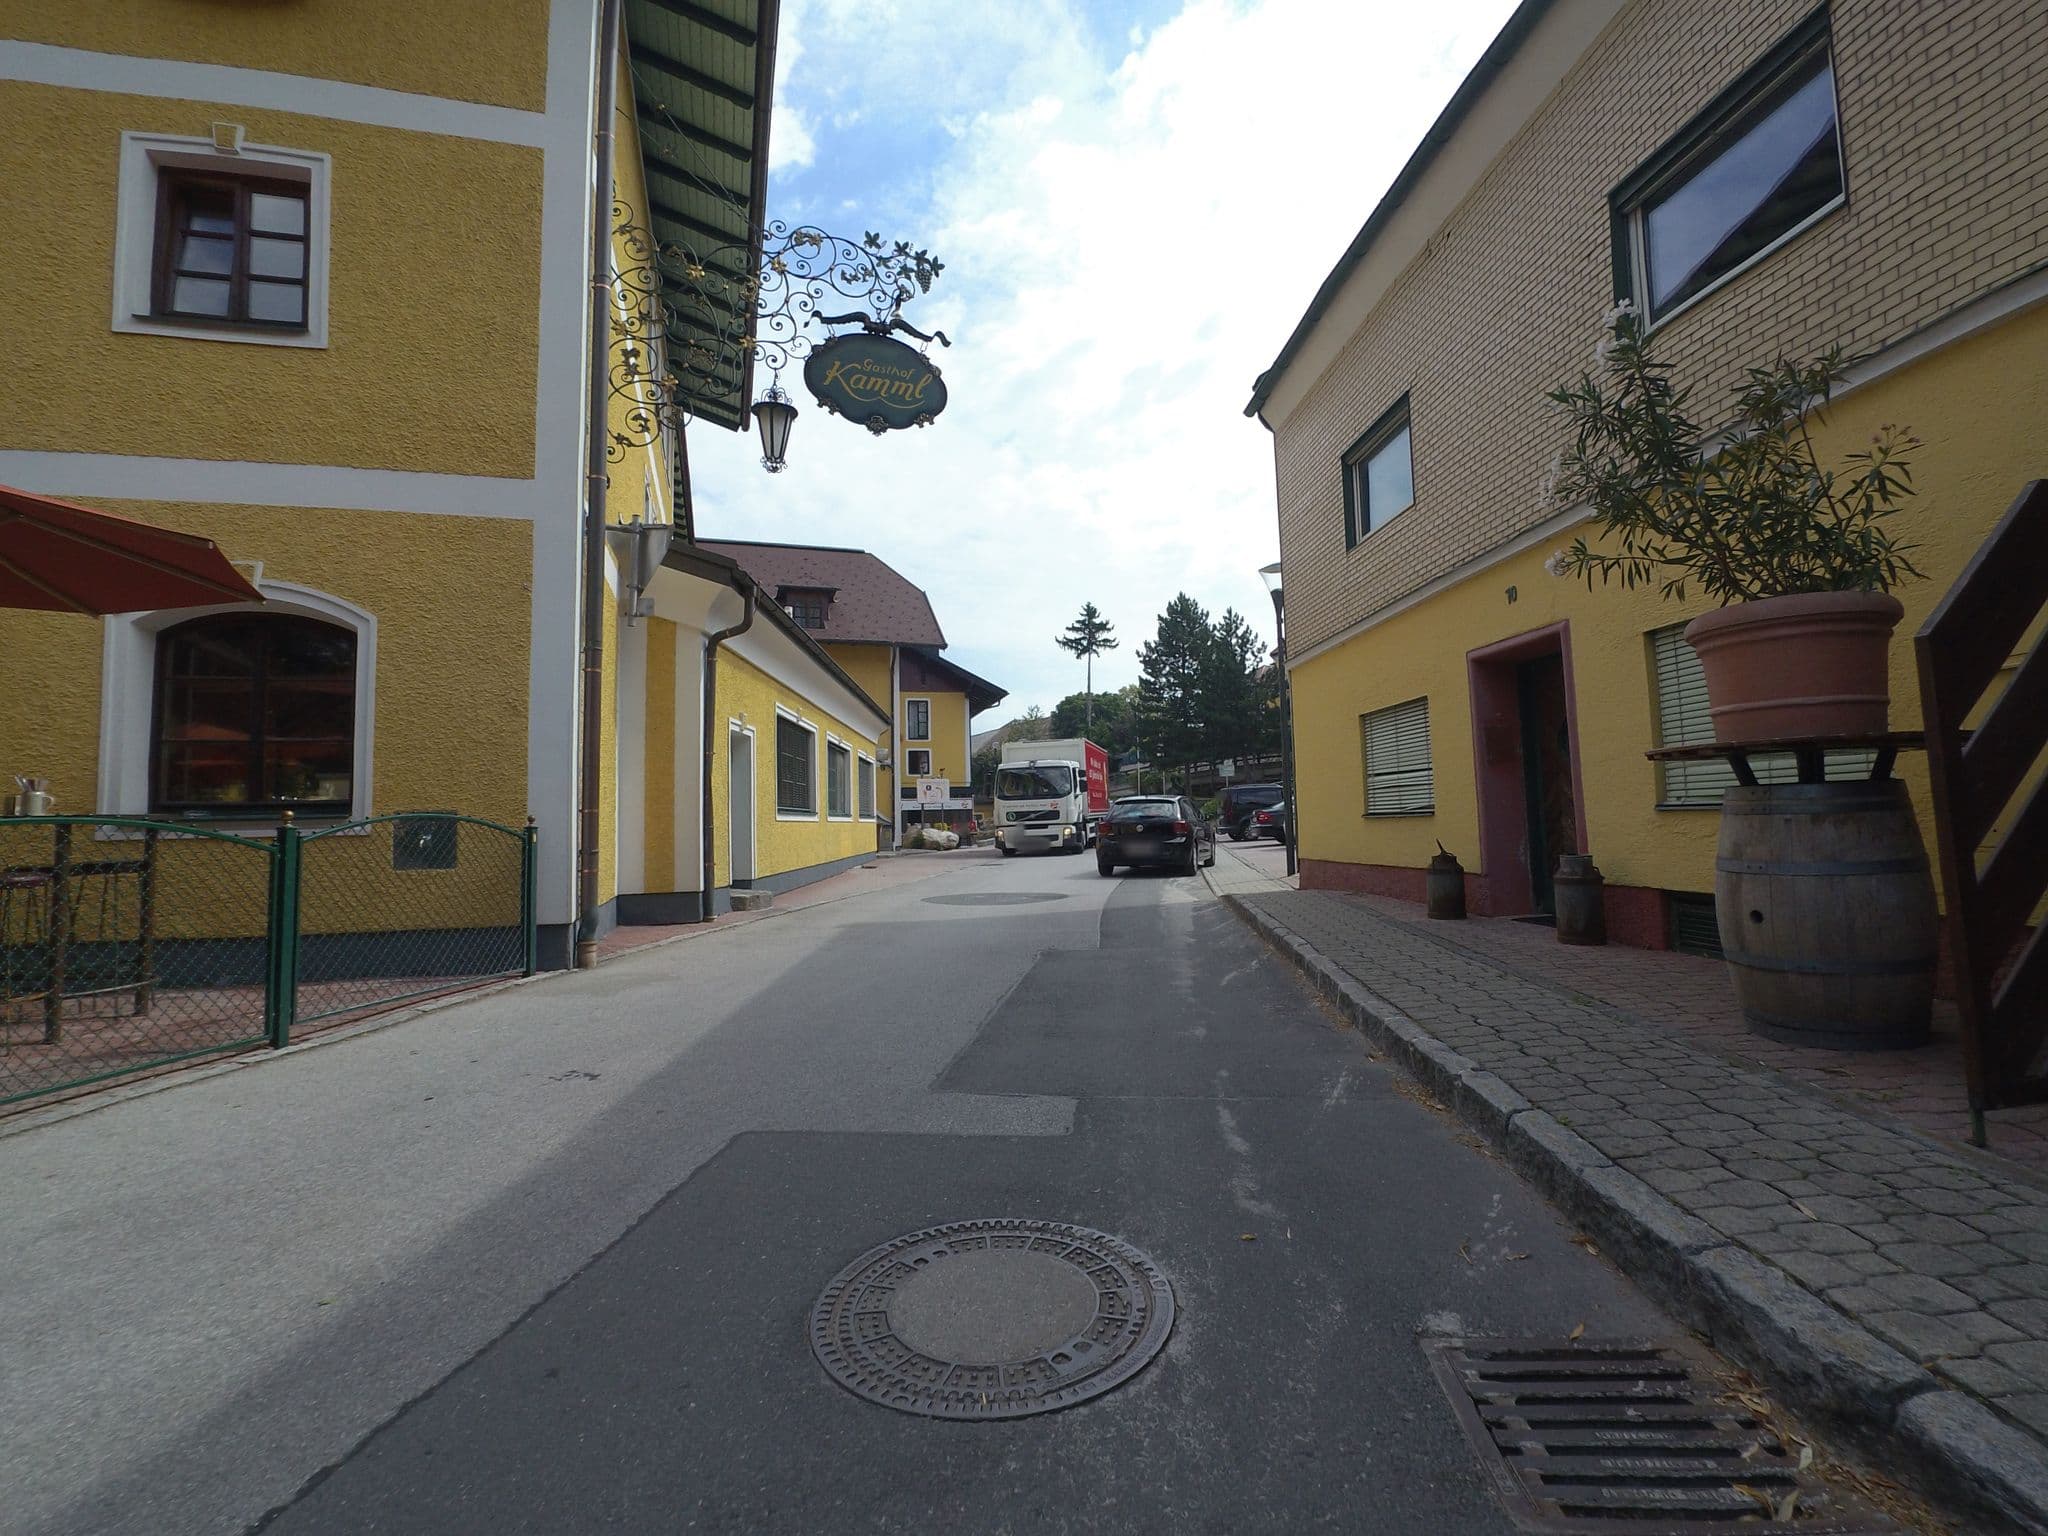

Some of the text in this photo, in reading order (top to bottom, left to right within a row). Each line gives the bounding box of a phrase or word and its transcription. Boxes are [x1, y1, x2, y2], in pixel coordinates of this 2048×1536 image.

[863, 358, 916, 380] Gasthof
[823, 361, 933, 402] Kamml
[1504, 585, 1518, 605] 10
